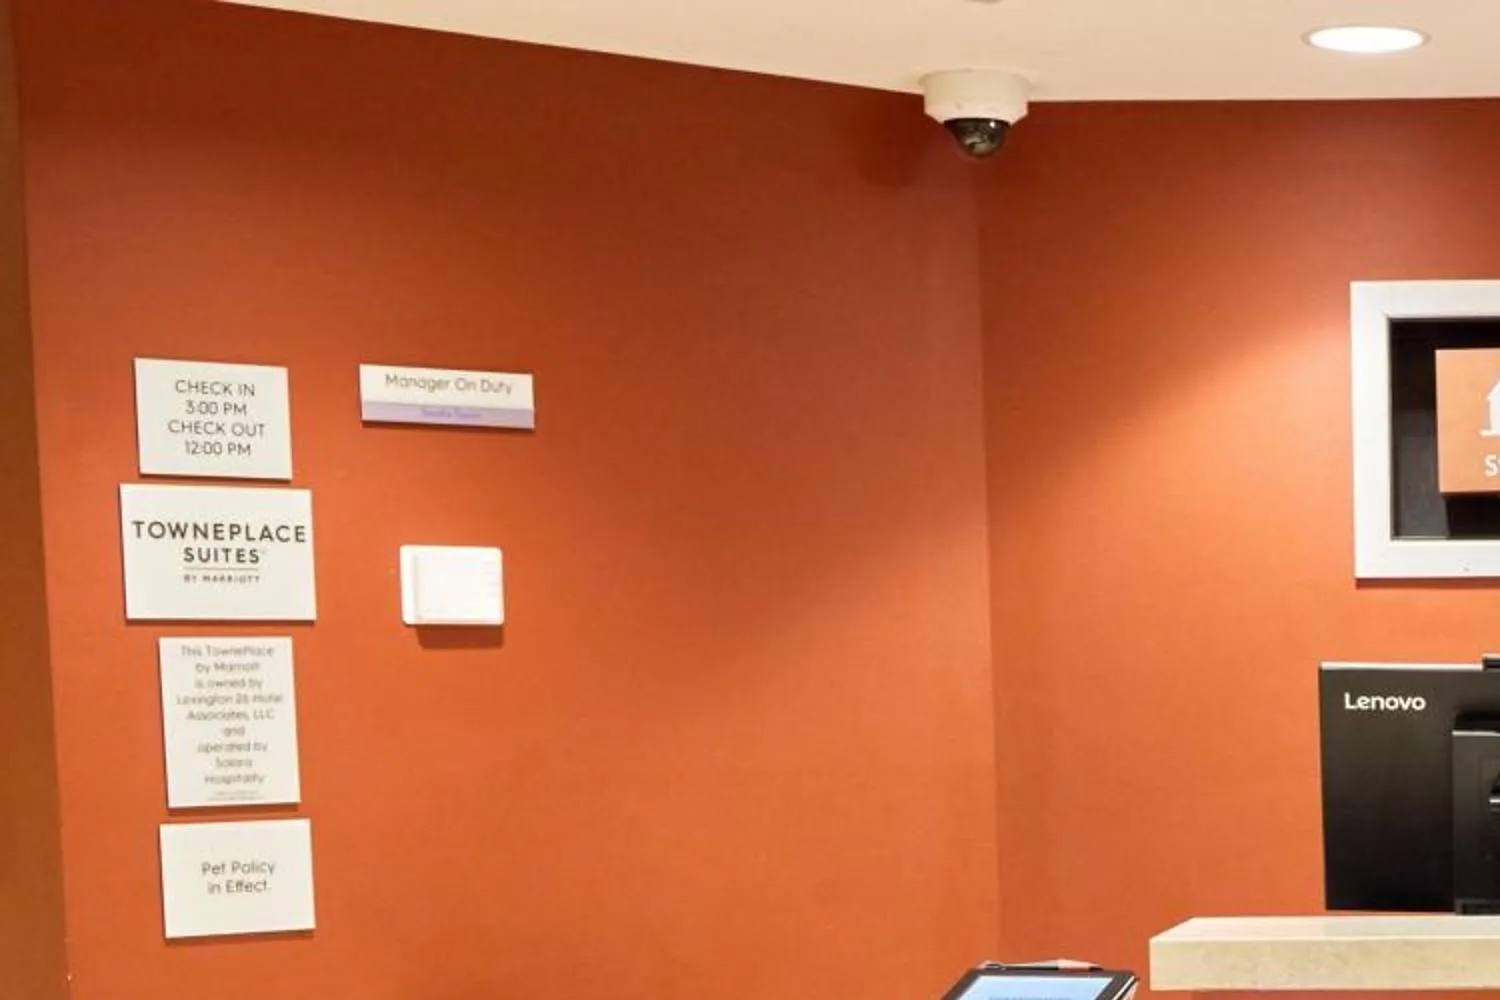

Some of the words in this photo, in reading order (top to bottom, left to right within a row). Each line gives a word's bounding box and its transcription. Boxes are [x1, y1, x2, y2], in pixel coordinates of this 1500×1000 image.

[175, 379, 233, 396] CHECK
[237, 382, 256, 398] IN
[385, 372, 450, 394] Manager
[453, 376, 476, 392] On
[480, 378, 513, 397] Duty
[185, 400, 219, 415] 3:00
[223, 402, 248, 416] PM
[167, 419, 225, 435] CHECK
[231, 422, 266, 438] OUT
[184, 440, 223, 456] 12:00
[227, 441, 251, 457] PM
[132, 520, 307, 544] TOWNEPLACE
[183, 546, 260, 564] SUITES
[1344, 691, 1426, 711] Lenovo
[201, 860, 226, 876] Pet
[231, 860, 275, 876] Policy
[207, 881, 221, 895] in
